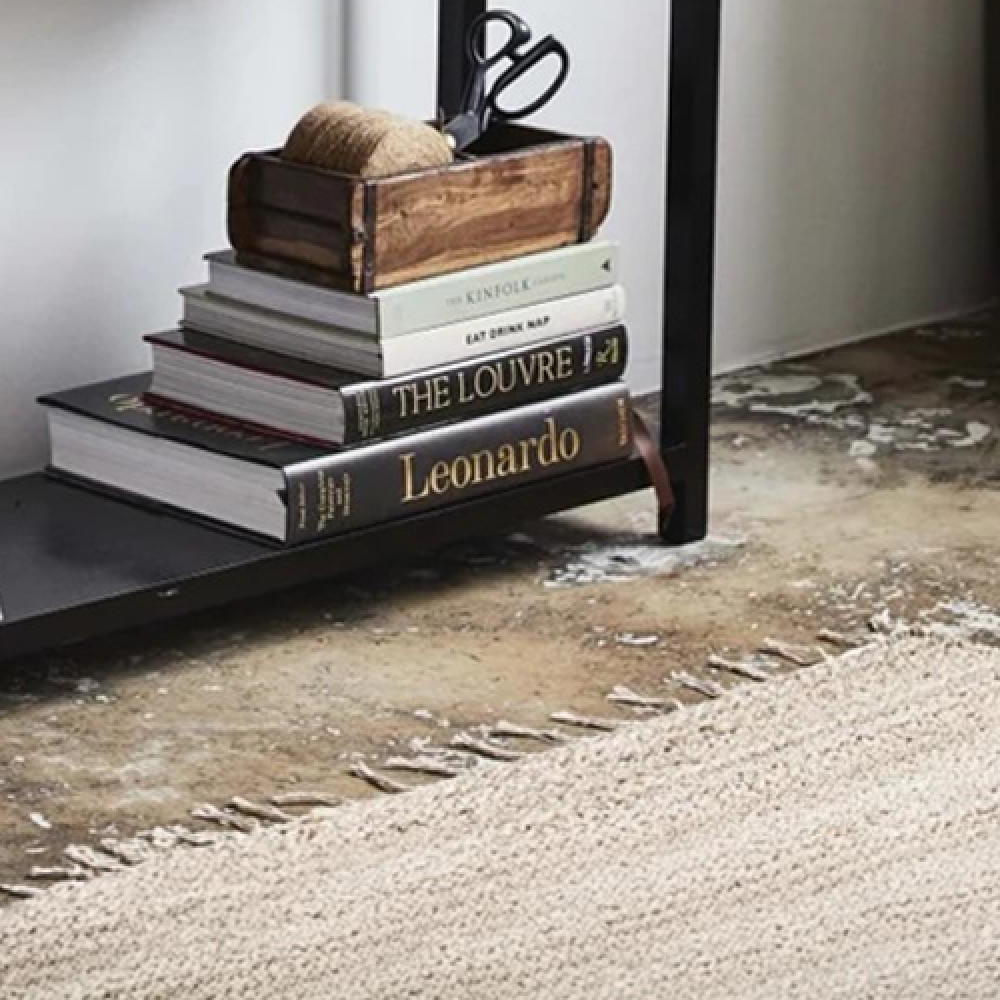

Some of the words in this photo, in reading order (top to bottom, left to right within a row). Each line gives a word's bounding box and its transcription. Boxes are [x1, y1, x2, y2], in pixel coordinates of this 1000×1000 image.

[466, 278, 529, 305] KINFOLK
[465, 330, 487, 345] EAT
[489, 322, 524, 339] DRINK
[527, 315, 550, 329] NAP
[392, 376, 450, 416] THE
[457, 345, 574, 403] LOUVRE
[399, 416, 581, 503] Leonardo
